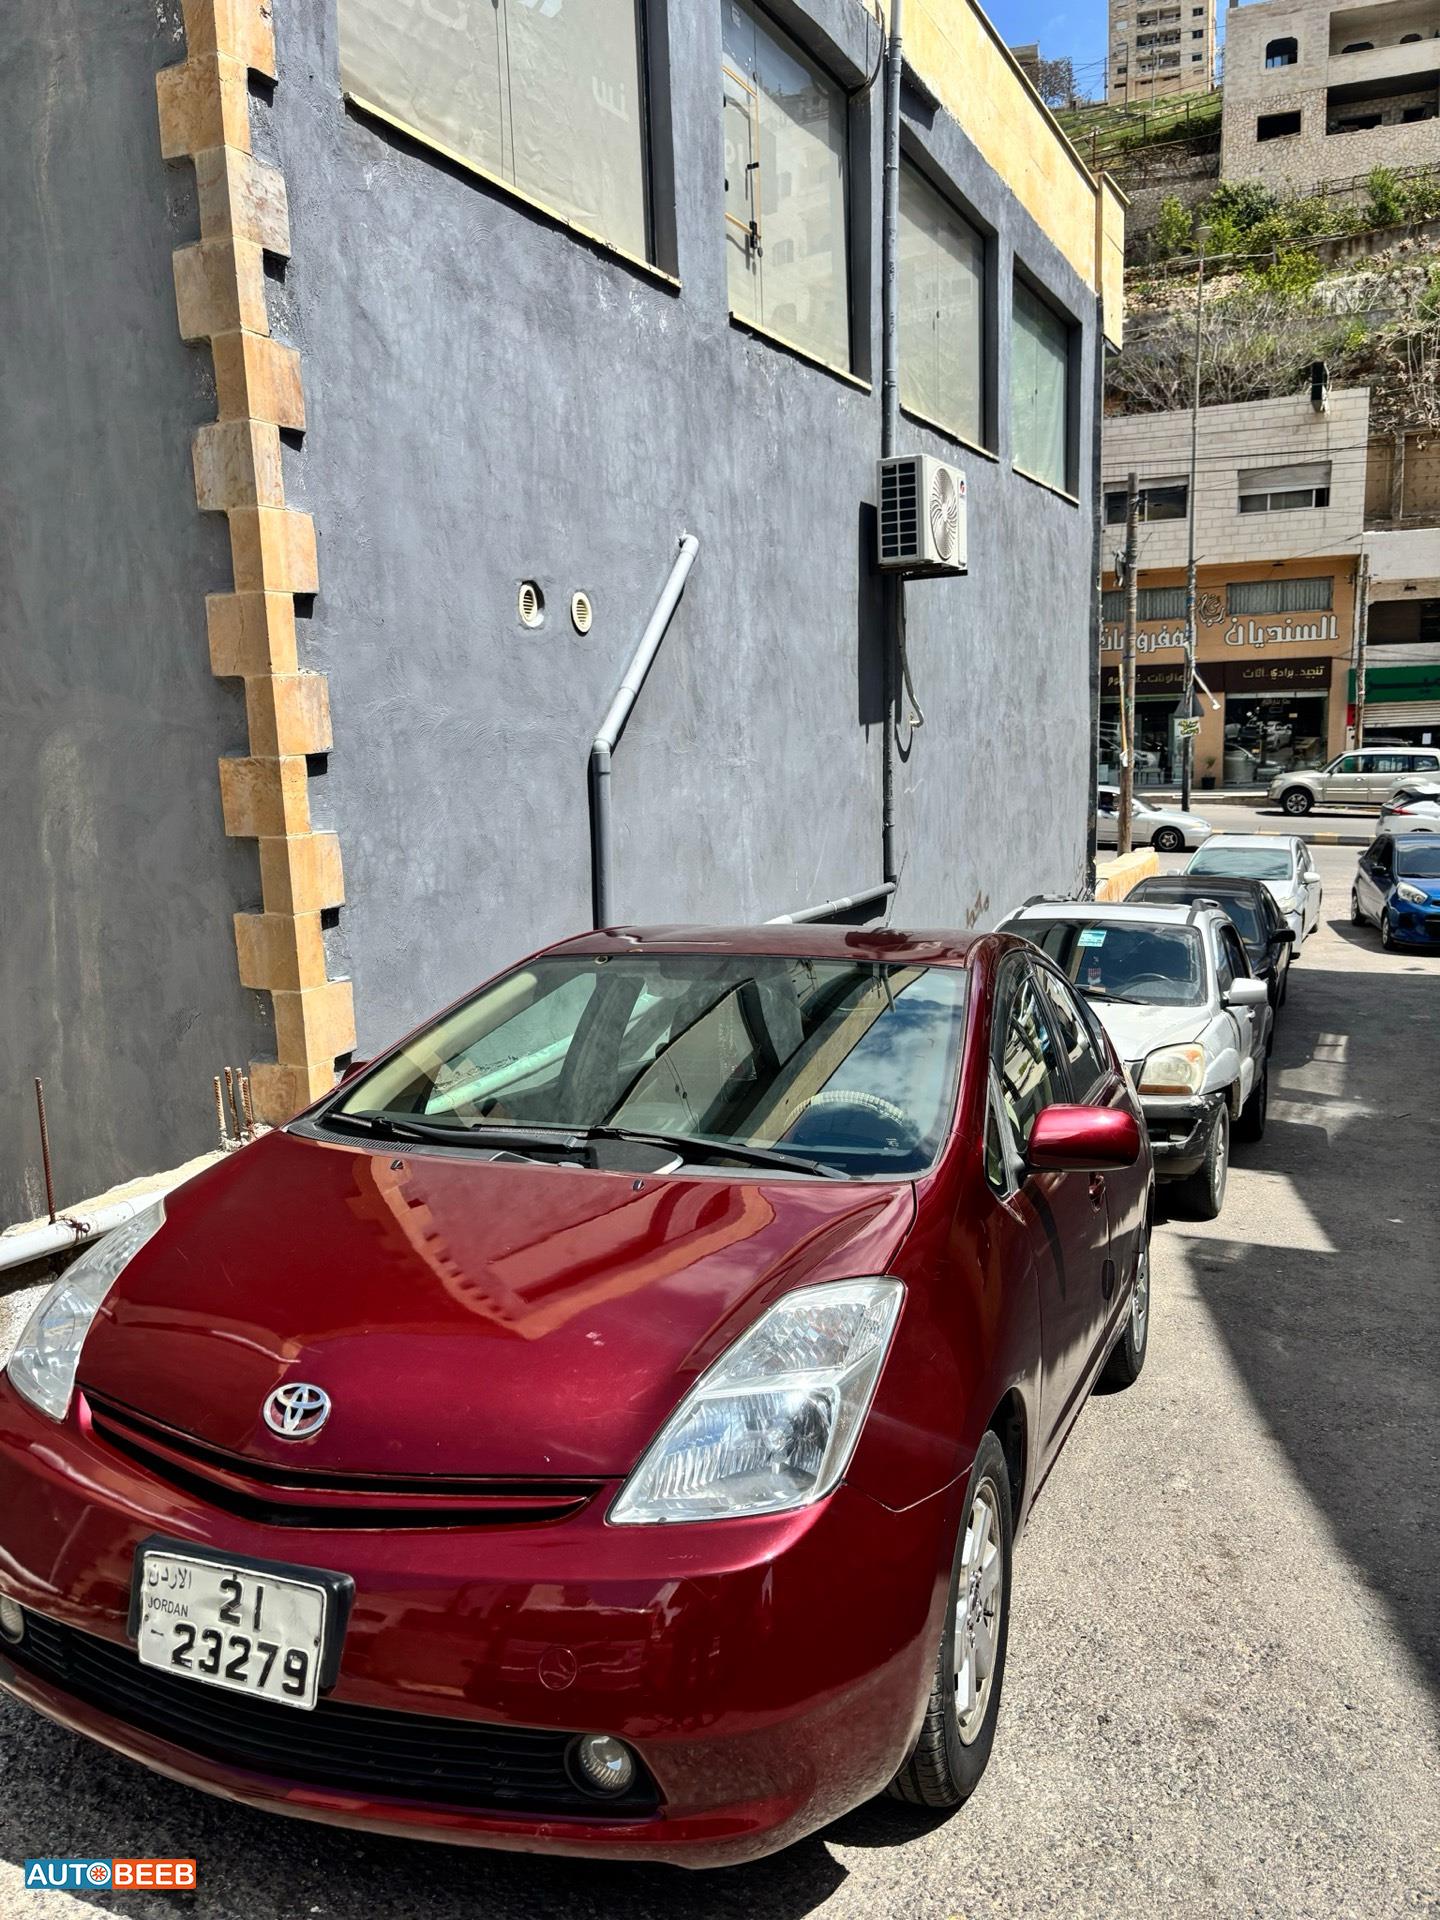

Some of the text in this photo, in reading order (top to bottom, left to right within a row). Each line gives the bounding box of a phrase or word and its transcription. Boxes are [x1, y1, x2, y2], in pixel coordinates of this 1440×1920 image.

[1225, 615, 1339, 648] السنديان
[1269, 667, 1294, 680] برادي
[1299, 666, 1325, 679] تنجيد
[148, 1597, 189, 1618] JORDAN
[219, 1578, 264, 1632] 21
[171, 1623, 308, 1697] 23279
